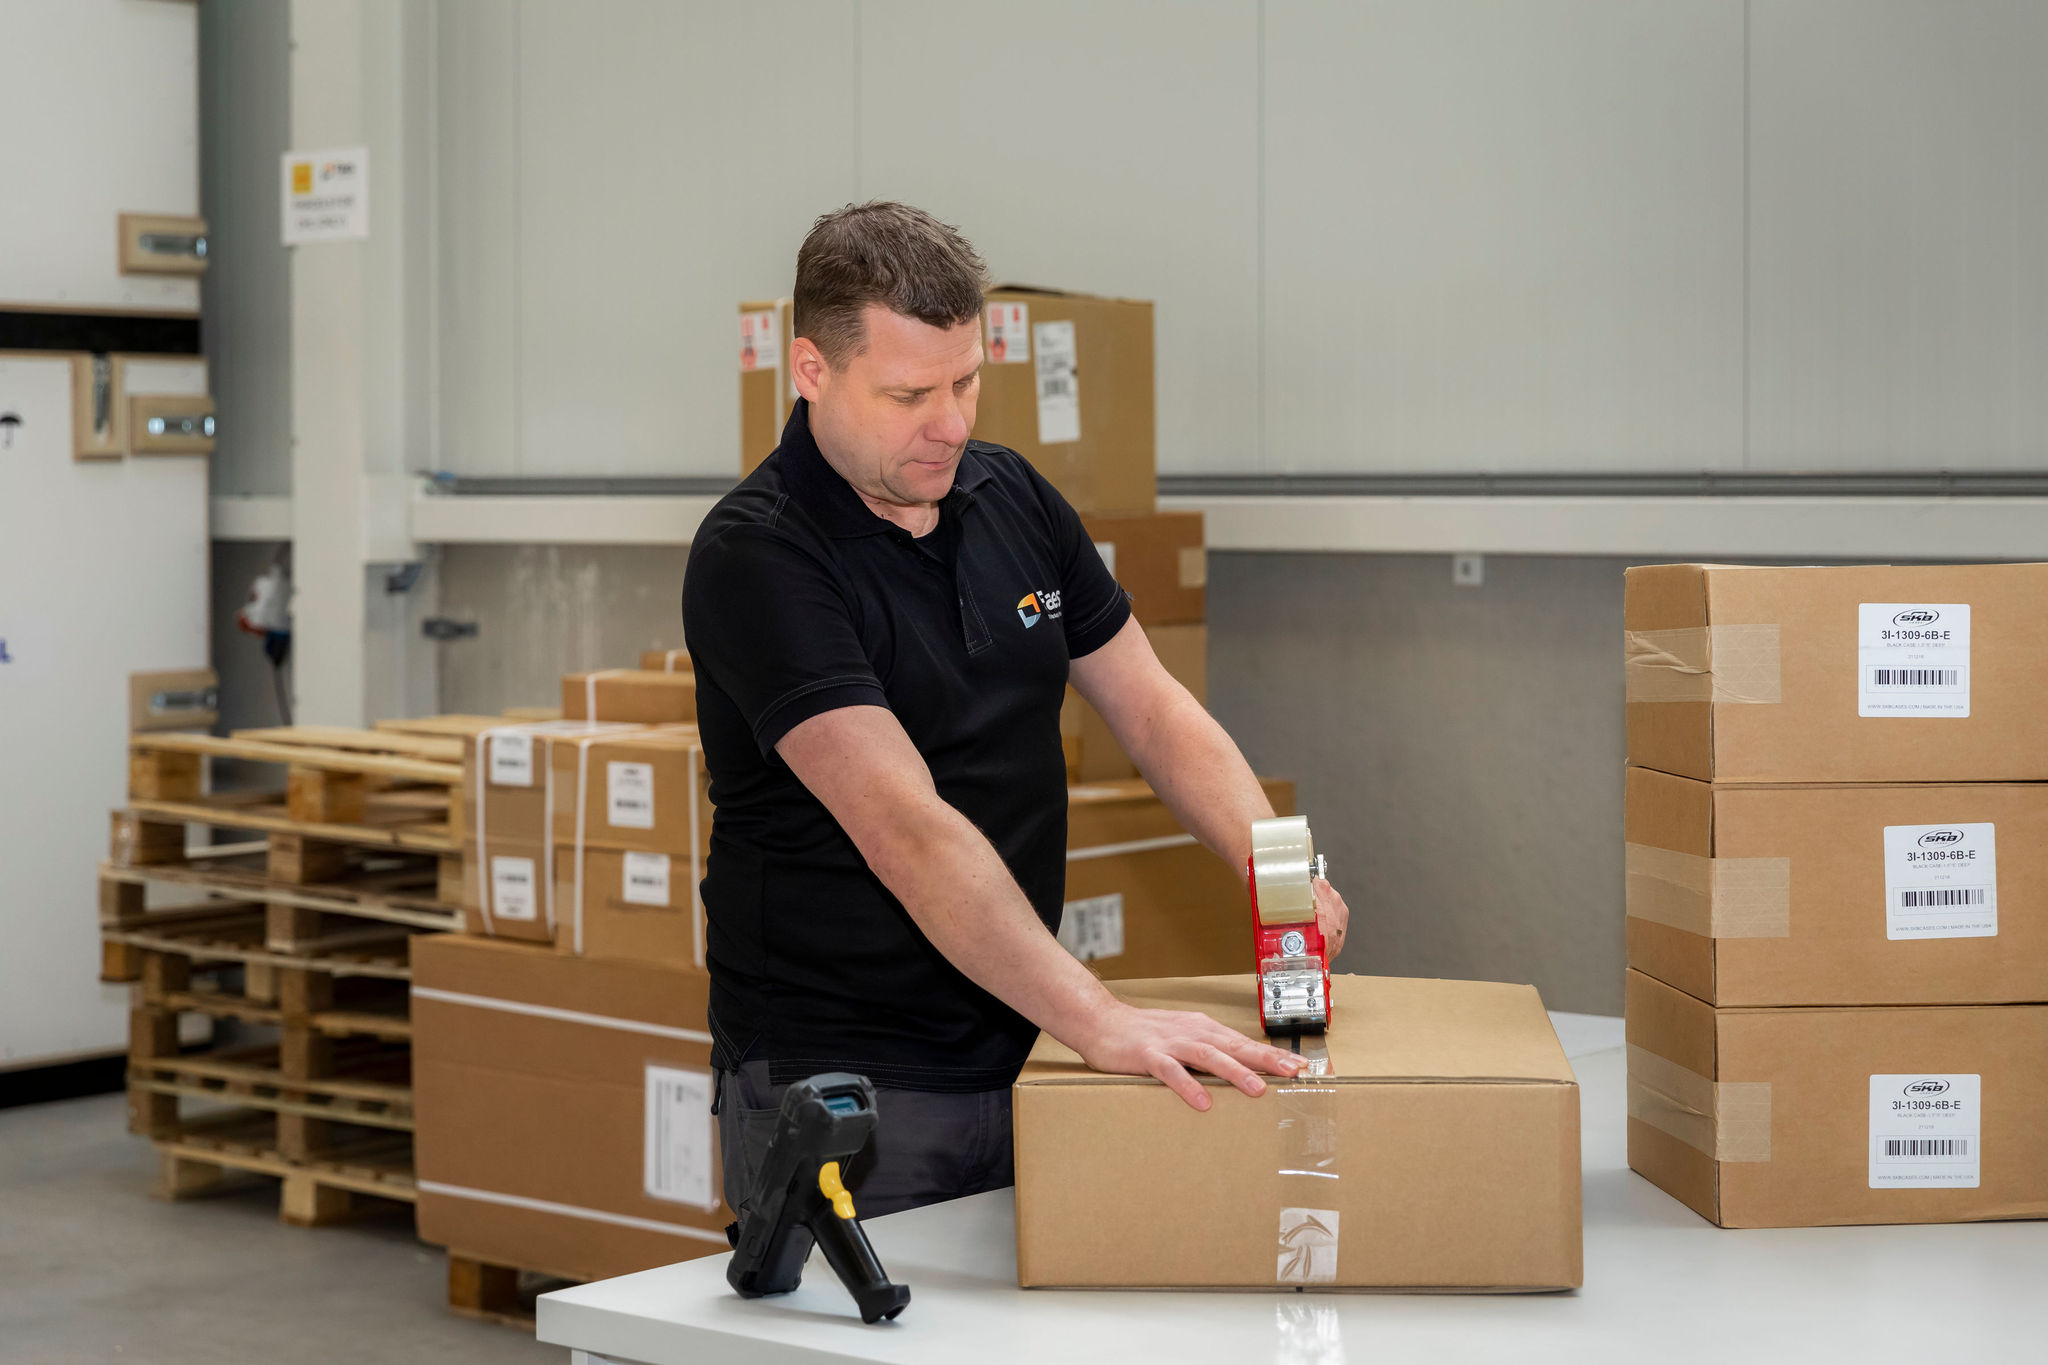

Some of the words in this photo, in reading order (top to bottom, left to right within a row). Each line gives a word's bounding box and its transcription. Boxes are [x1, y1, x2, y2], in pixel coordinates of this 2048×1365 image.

[1899, 612, 1934, 621] SKB
[1881, 630, 1951, 640] 3I-1309-6B-E
[1924, 832, 1958, 842] SKB
[1907, 850, 1976, 861] 3I-1309-6B-E
[1910, 1082, 1944, 1092] SKB
[1892, 1100, 1961, 1110] 3I-1309-6B-E
